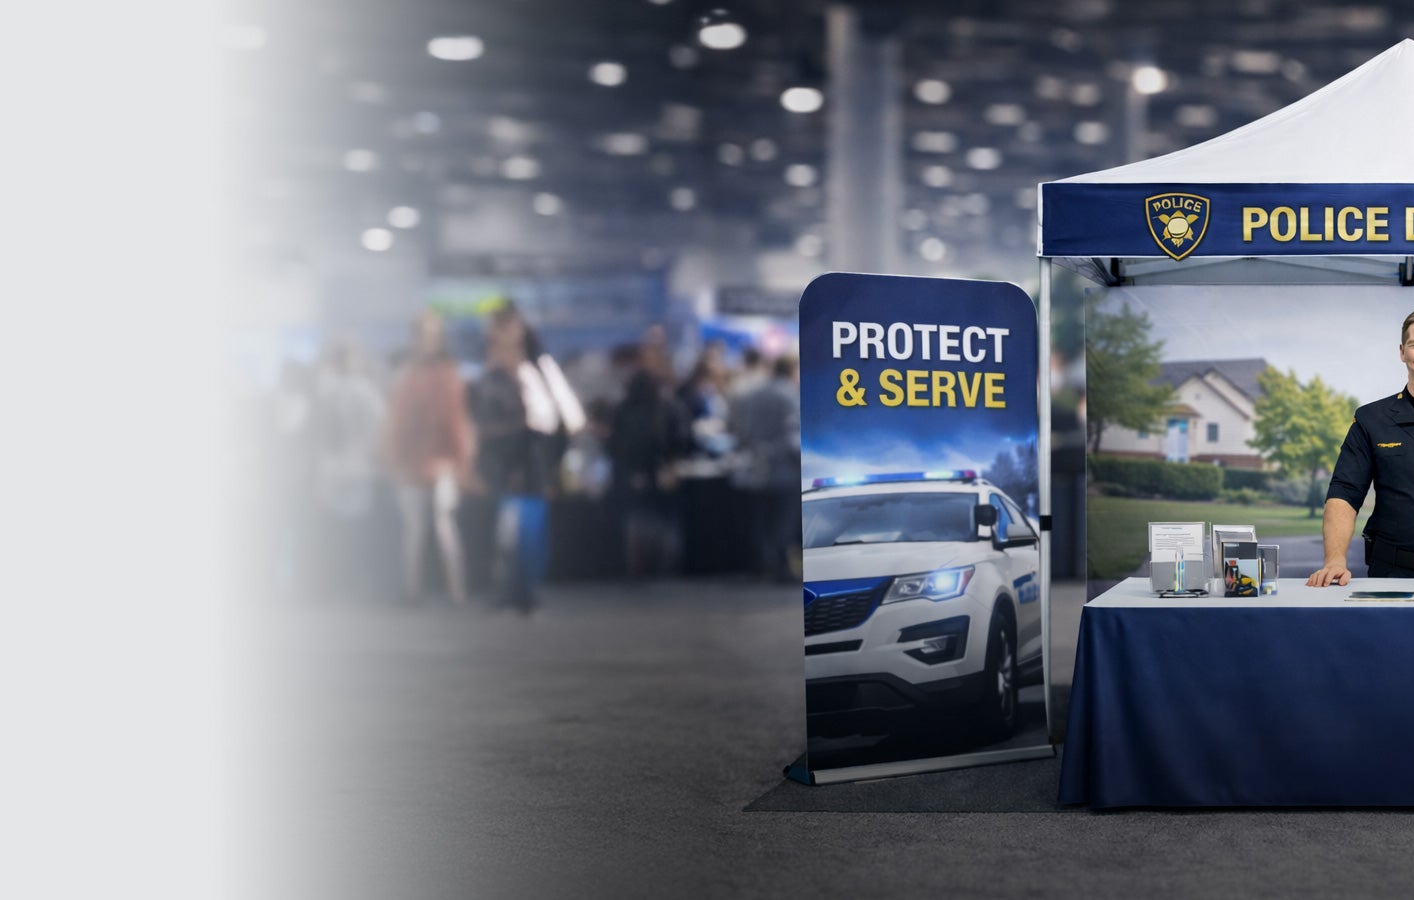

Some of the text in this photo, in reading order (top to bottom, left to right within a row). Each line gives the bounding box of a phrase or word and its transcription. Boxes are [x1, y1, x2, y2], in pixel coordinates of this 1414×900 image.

[1152, 197, 1203, 213] POLICE
[1242, 206, 1389, 242] POLICE
[831, 321, 1010, 363] PROTECT
[836, 367, 1007, 409] & SERVE
